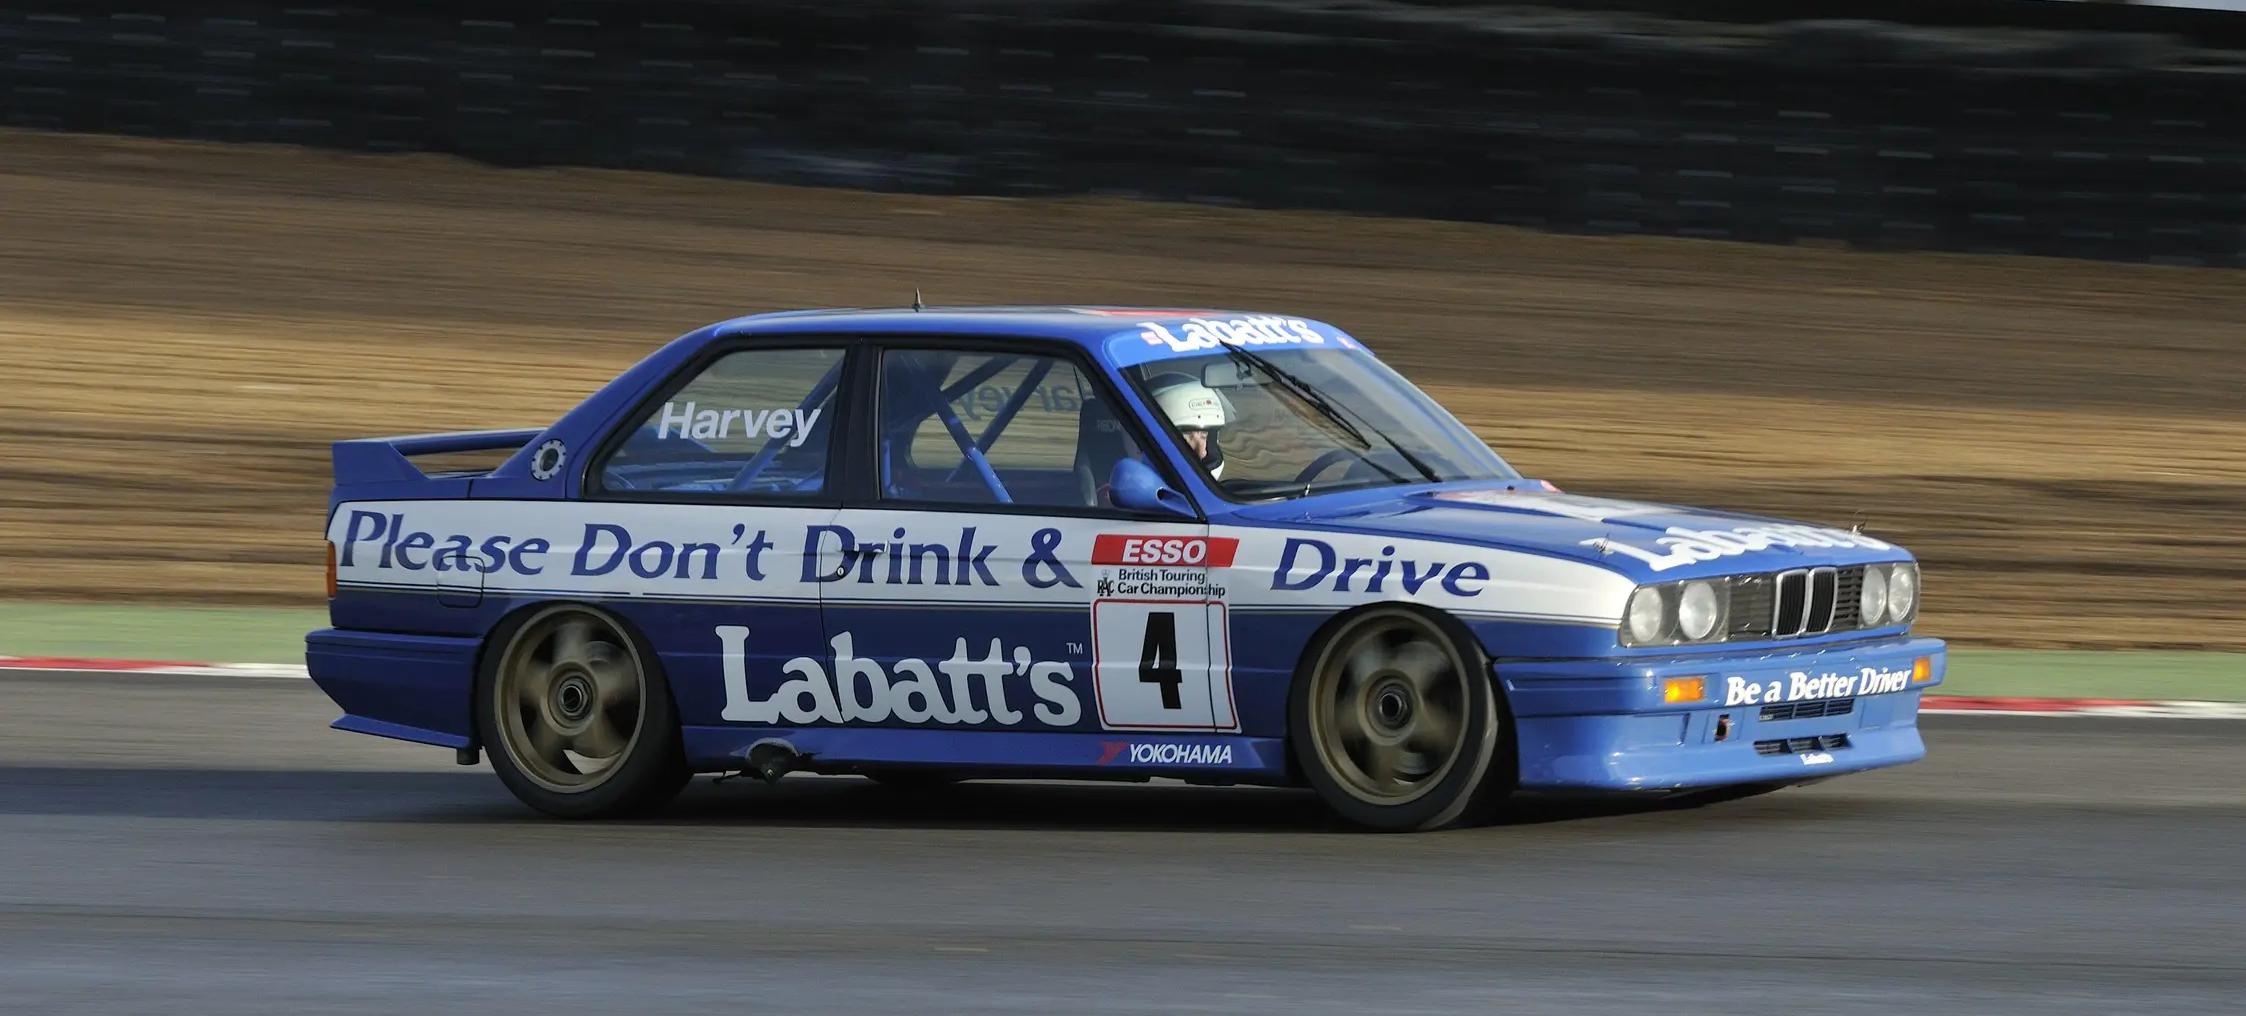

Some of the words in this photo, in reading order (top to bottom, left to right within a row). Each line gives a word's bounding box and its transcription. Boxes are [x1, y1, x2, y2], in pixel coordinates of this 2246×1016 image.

[1137, 316, 1324, 351] Labatt's
[658, 400, 821, 447] Harvey
[340, 509, 550, 575] Please
[570, 522, 774, 579] Don't
[800, 523, 1000, 587] Drink
[1021, 526, 1082, 588] &
[1270, 537, 1490, 597] Drive
[1122, 539, 1207, 564] ESSO
[1117, 582, 1139, 594] Car
[1140, 582, 1226, 598] Championship
[1118, 568, 1158, 582] British
[1159, 570, 1206, 584] Touring
[1066, 642, 1083, 653] TM
[1138, 612, 1182, 709] 4
[715, 625, 1082, 726] Labatt's
[1725, 676, 1761, 706] Be
[1763, 680, 1782, 703] a
[1787, 671, 1857, 701] Better
[1857, 667, 1912, 696] Driver
[1129, 743, 1232, 764] YOKOHAMA
